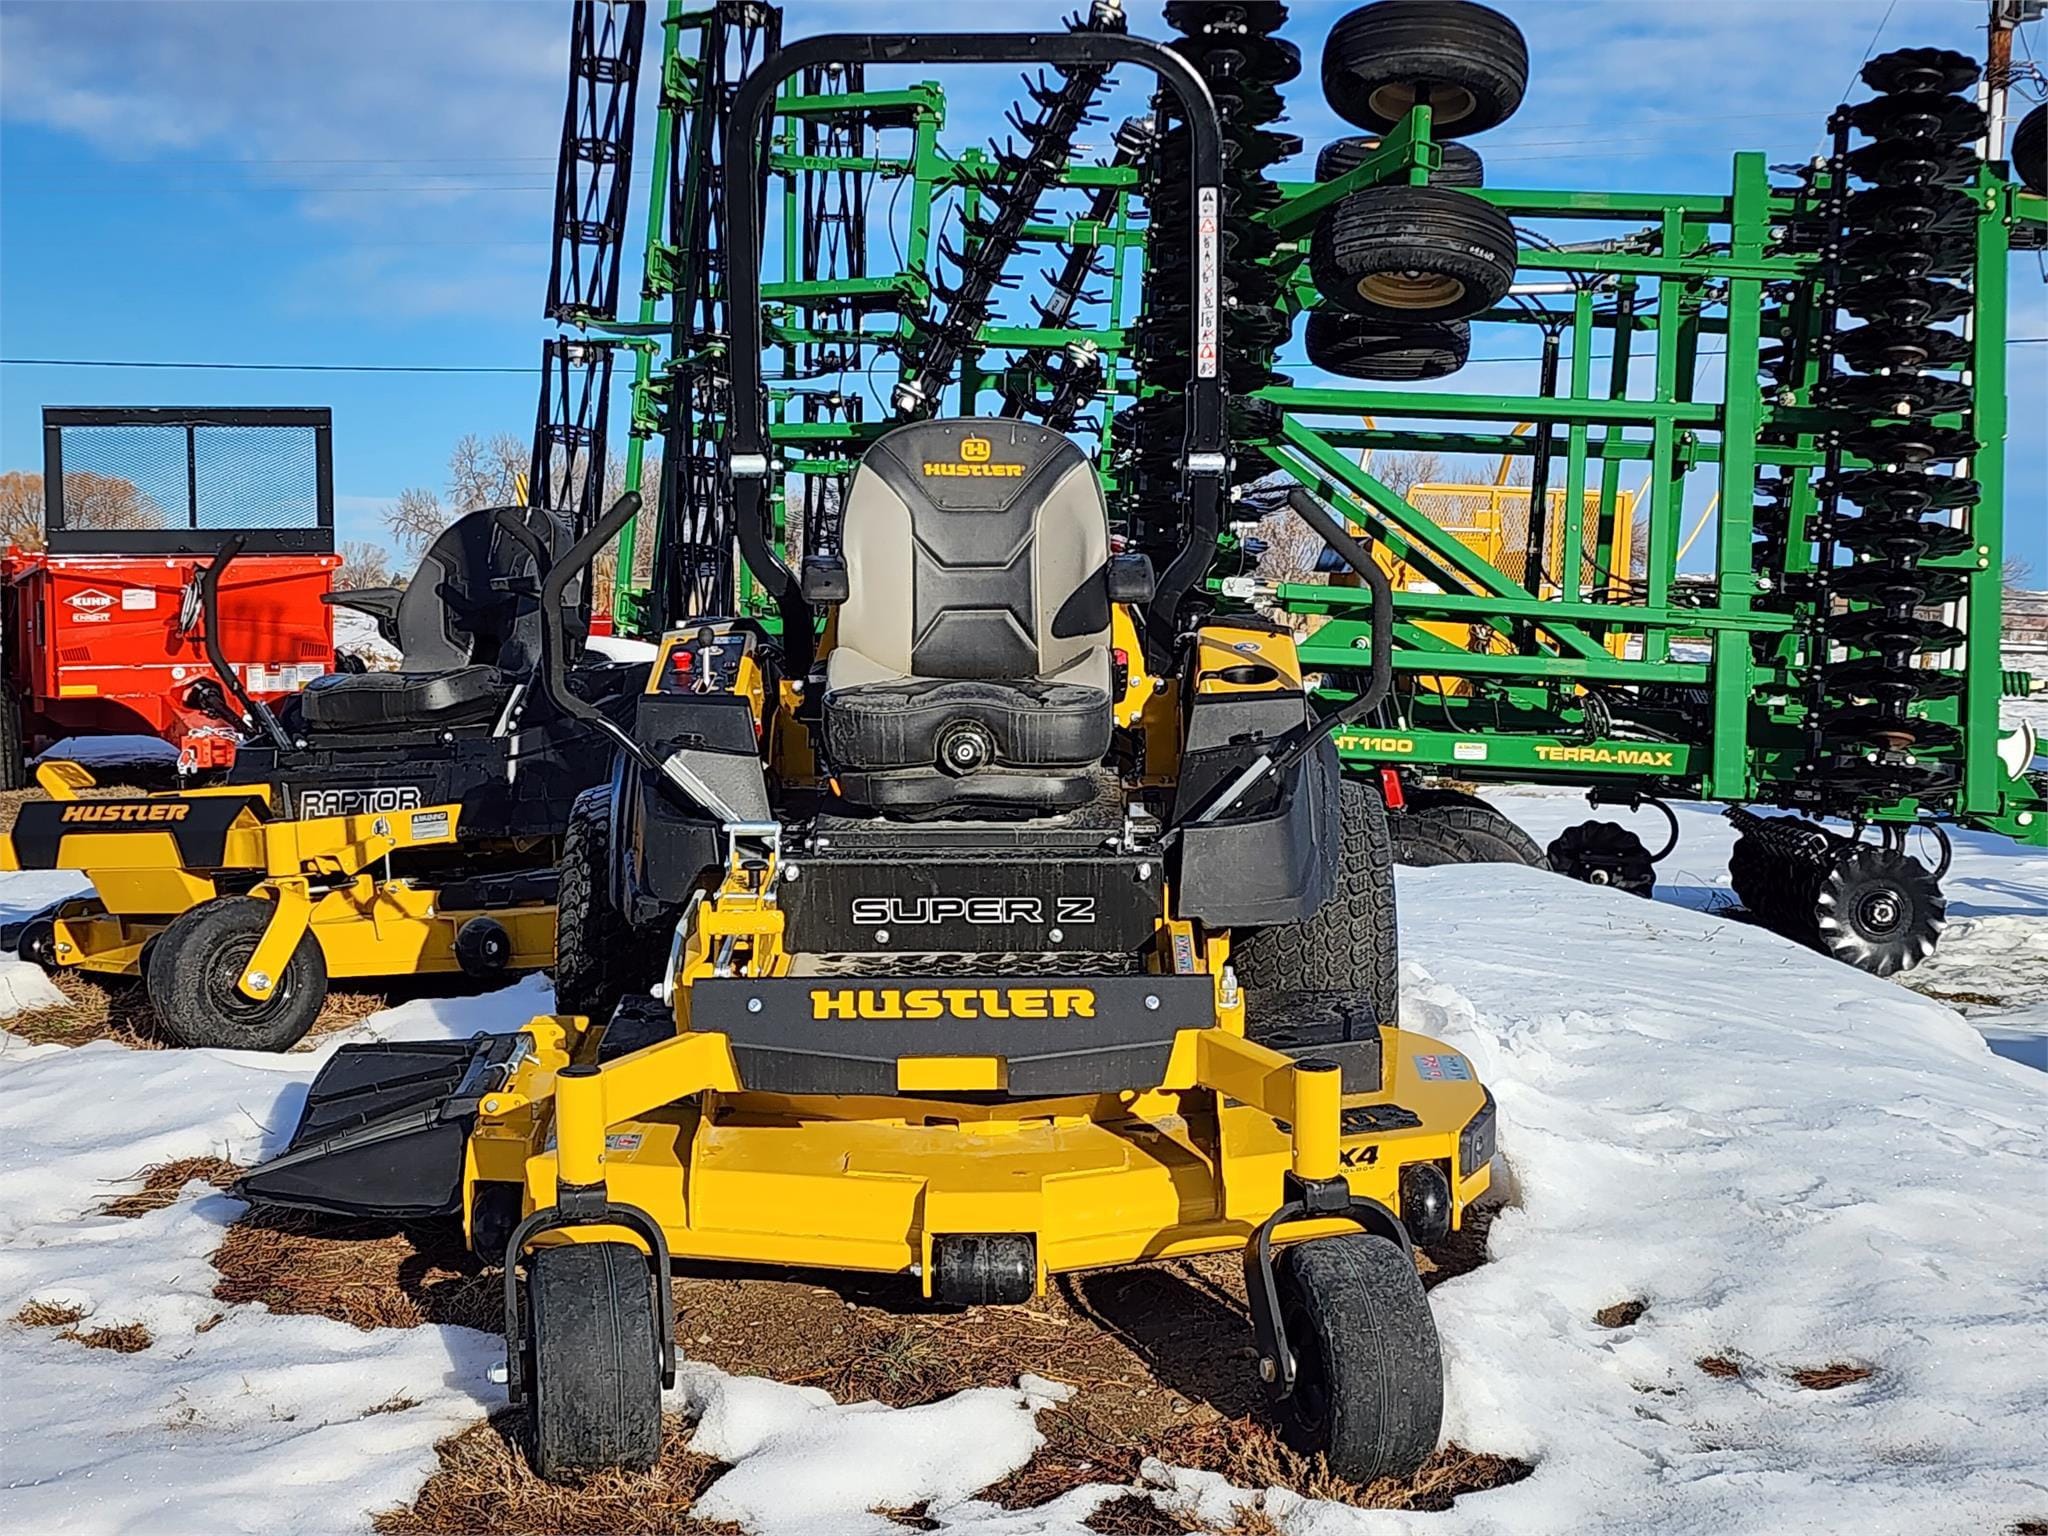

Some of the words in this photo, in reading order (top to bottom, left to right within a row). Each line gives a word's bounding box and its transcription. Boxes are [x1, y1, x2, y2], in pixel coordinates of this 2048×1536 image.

[923, 463, 1023, 477] HUSTLER
[1535, 746, 1673, 767] TERRA-MAX
[61, 804, 190, 822] HUSTLER
[301, 786, 422, 821] RAPTOR
[852, 897, 1044, 924] SUPER
[1057, 897, 1096, 924] Z
[810, 989, 1096, 1019] HUSTLER
